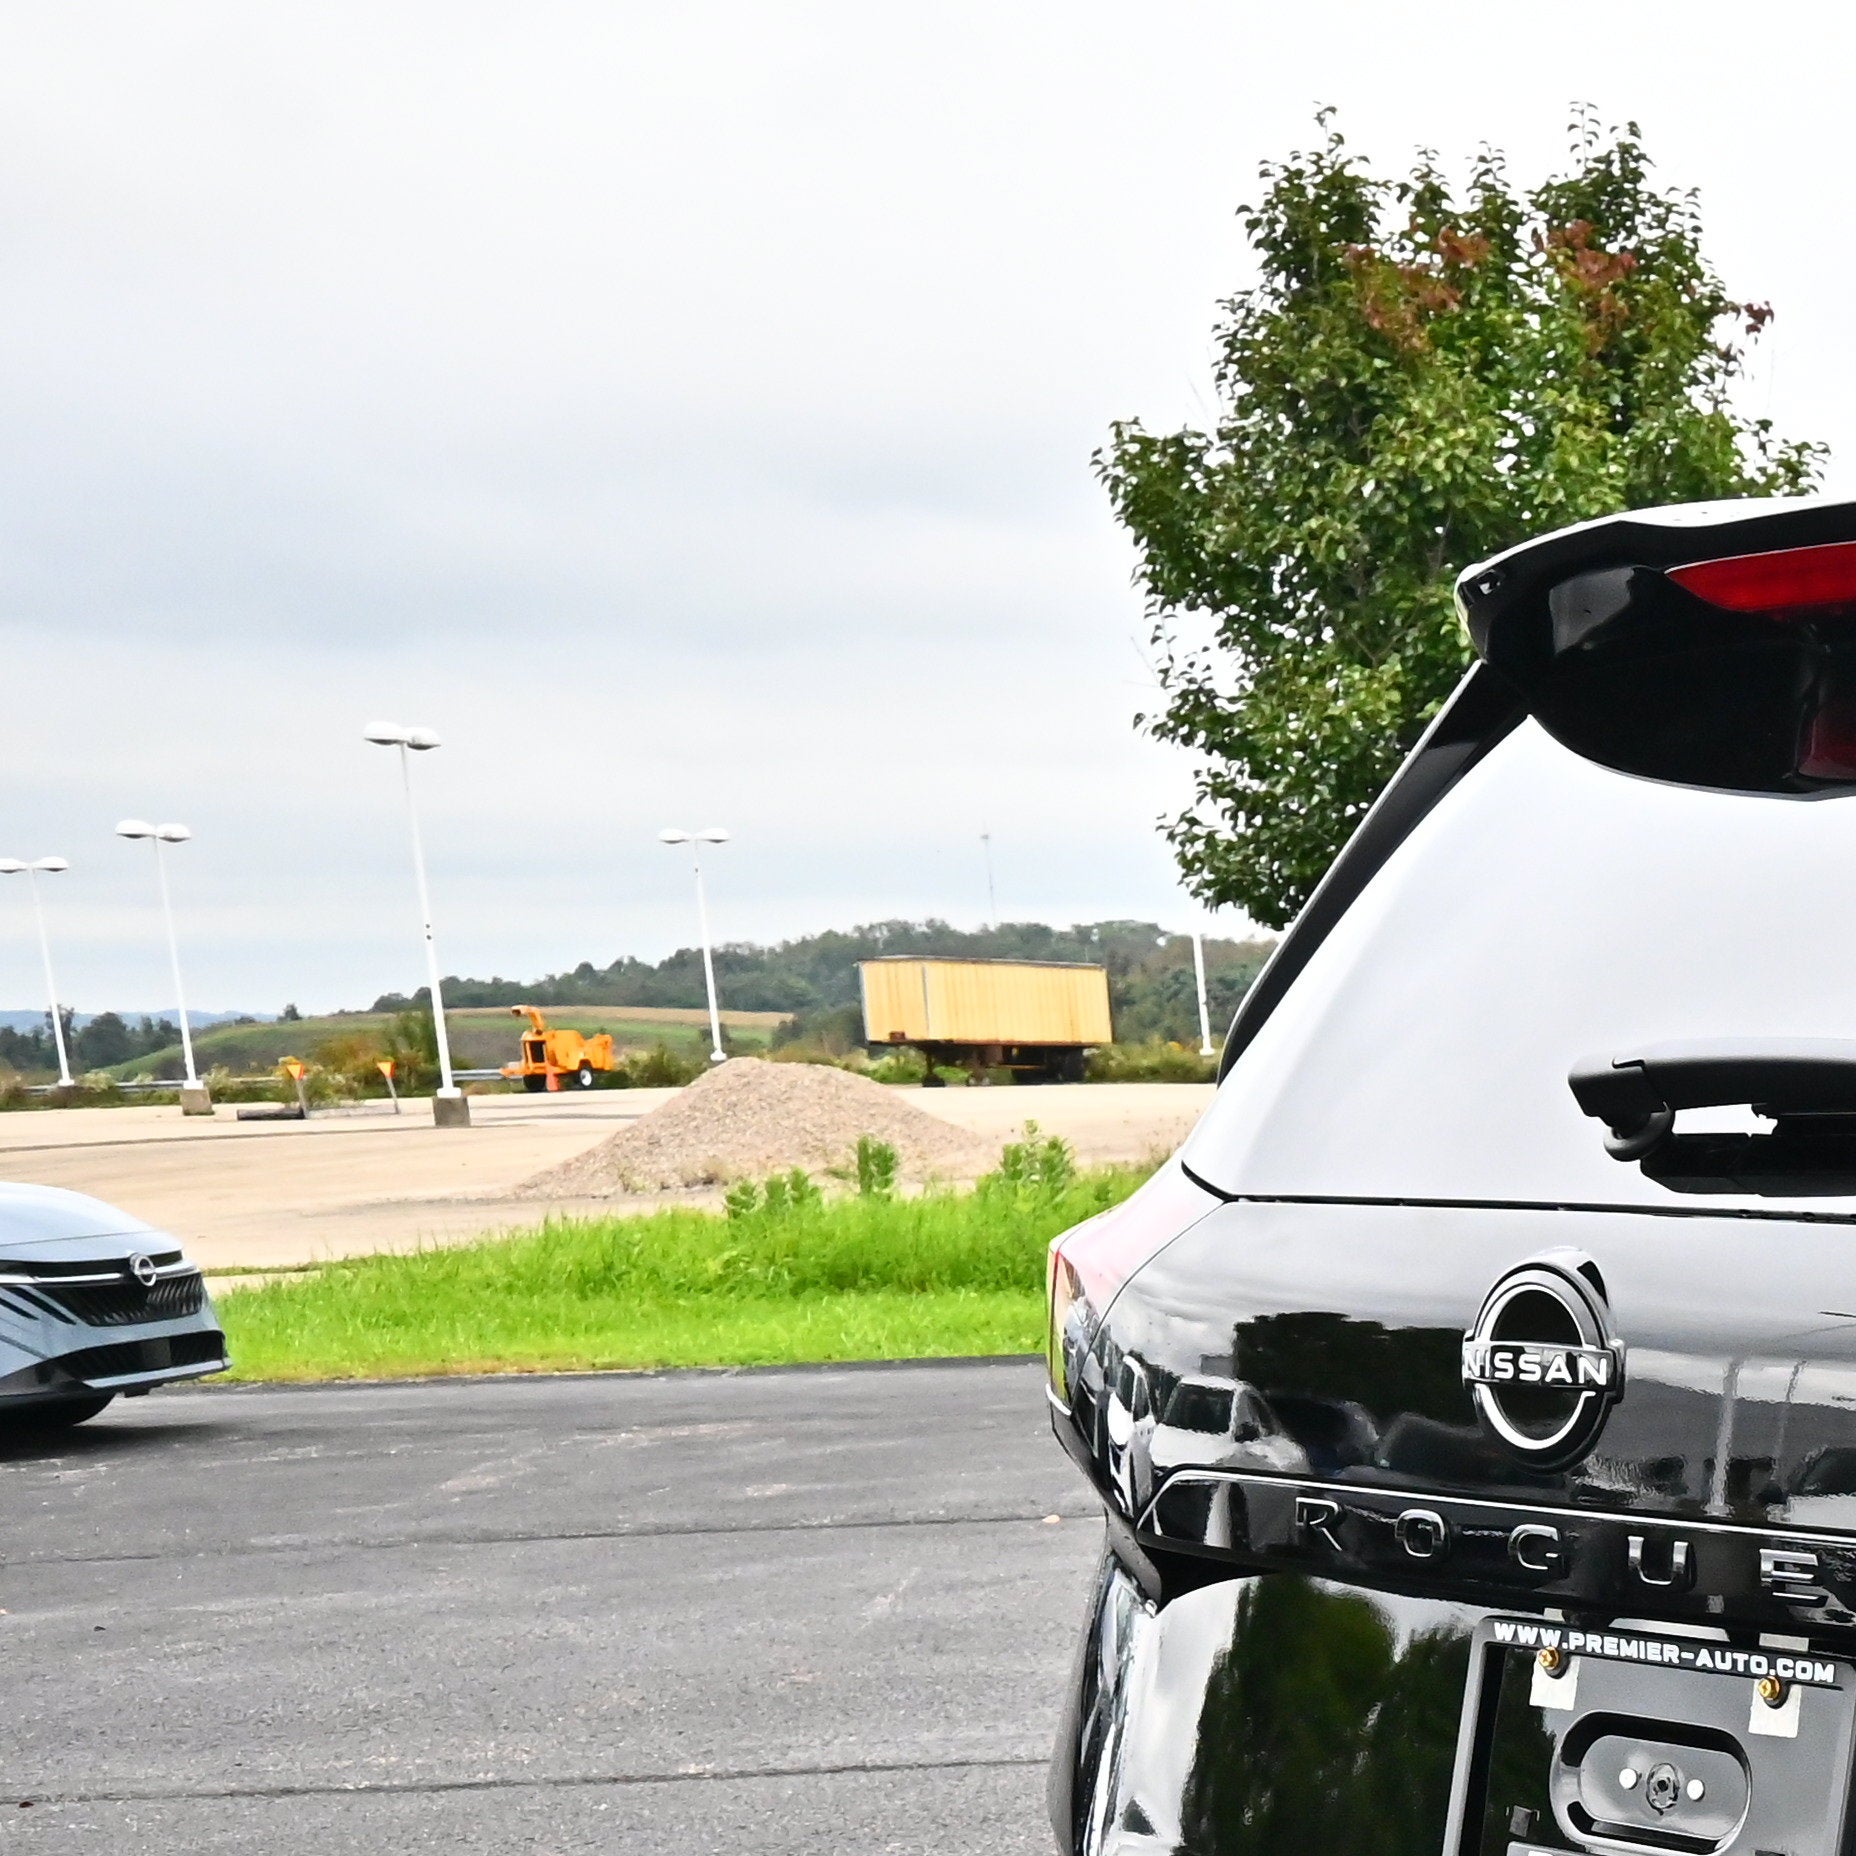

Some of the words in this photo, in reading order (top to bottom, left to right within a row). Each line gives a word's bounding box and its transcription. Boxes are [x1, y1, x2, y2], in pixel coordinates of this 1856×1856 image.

[1463, 1349, 1608, 1386] NISSAN
[1295, 1497, 1826, 1601] ROGUE
[1494, 1622, 1834, 1684] WWW.PREMIER-AUTO.COM
